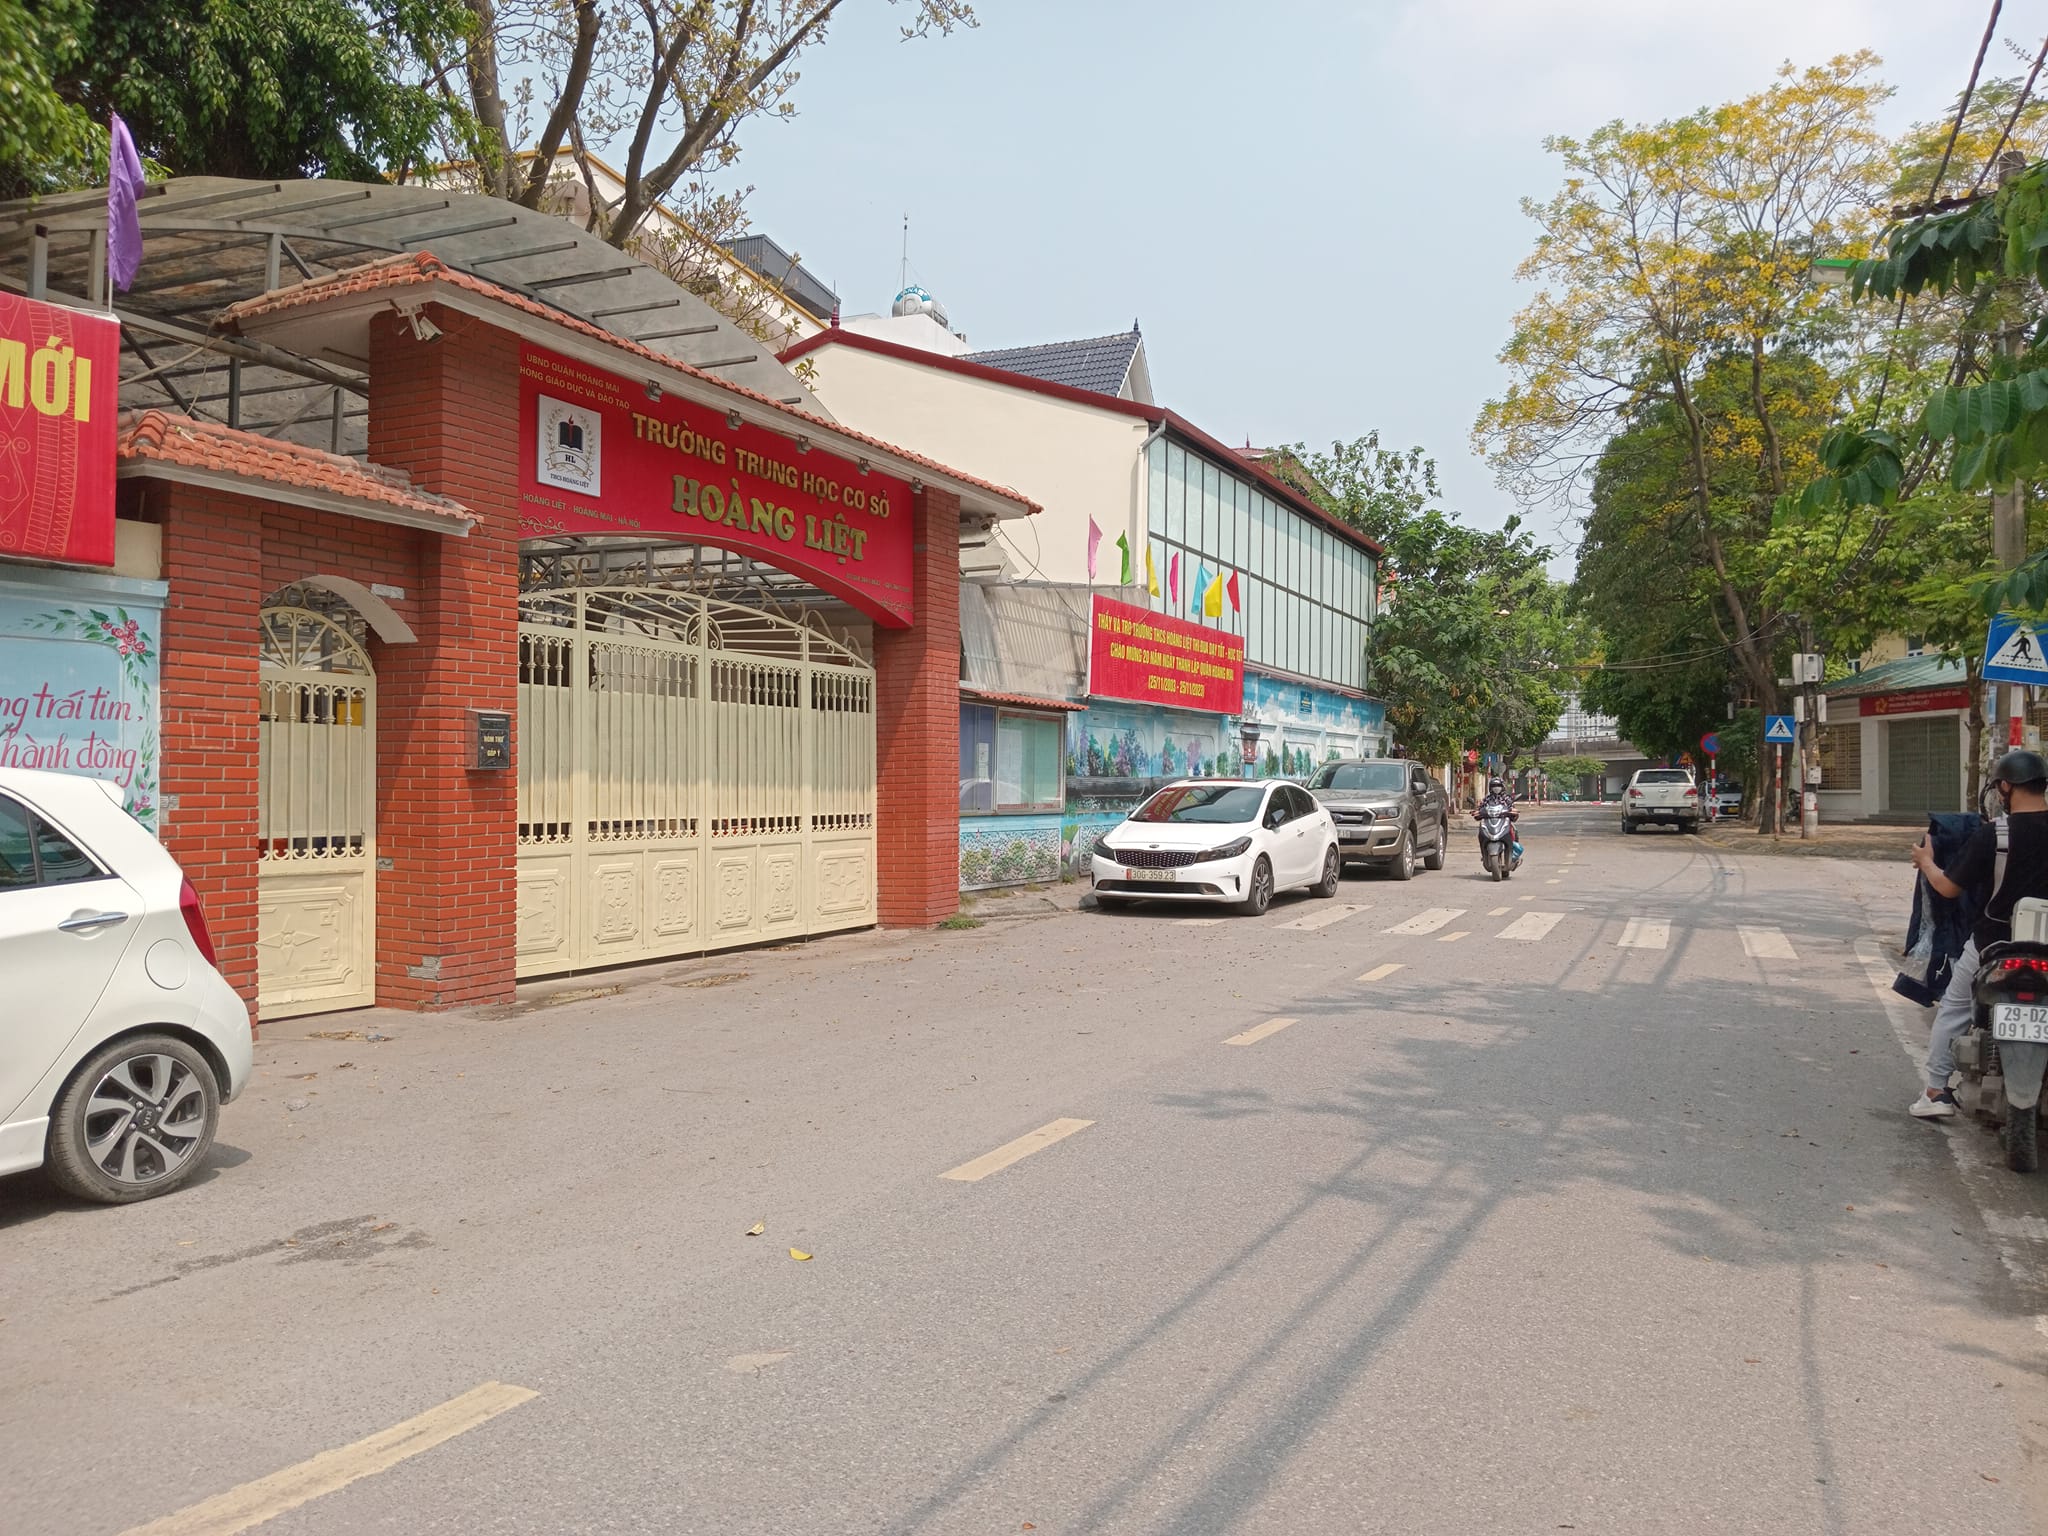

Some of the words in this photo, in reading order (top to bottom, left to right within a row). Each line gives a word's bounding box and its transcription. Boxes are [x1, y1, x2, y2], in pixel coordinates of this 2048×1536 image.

[519, 365, 544, 381] HÒNG
[545, 374, 565, 389] GIÁO
[585, 388, 596, 399] VÀ
[526, 353, 550, 368] UBND
[605, 383, 620, 392] MAI
[565, 454, 576, 464] HL
[632, 412, 726, 465] TRƯỜNG
[735, 448, 798, 489] TRUNG
[803, 471, 839, 504] HỌC
[842, 485, 865, 510] CƠ
[870, 489, 890, 519] SỞ
[550, 473, 562, 481] THCS
[551, 498, 567, 511] LIỆT
[600, 512, 613, 522] MAI
[618, 514, 627, 526] HÀ
[672, 477, 797, 542] HOÀNG
[804, 513, 868, 564] LIỆT
[1110, 639, 1125, 660] CHÀO
[1143, 649, 1149, 664] 20
[0, 697, 29, 737] ng
[32, 682, 86, 719] trái
